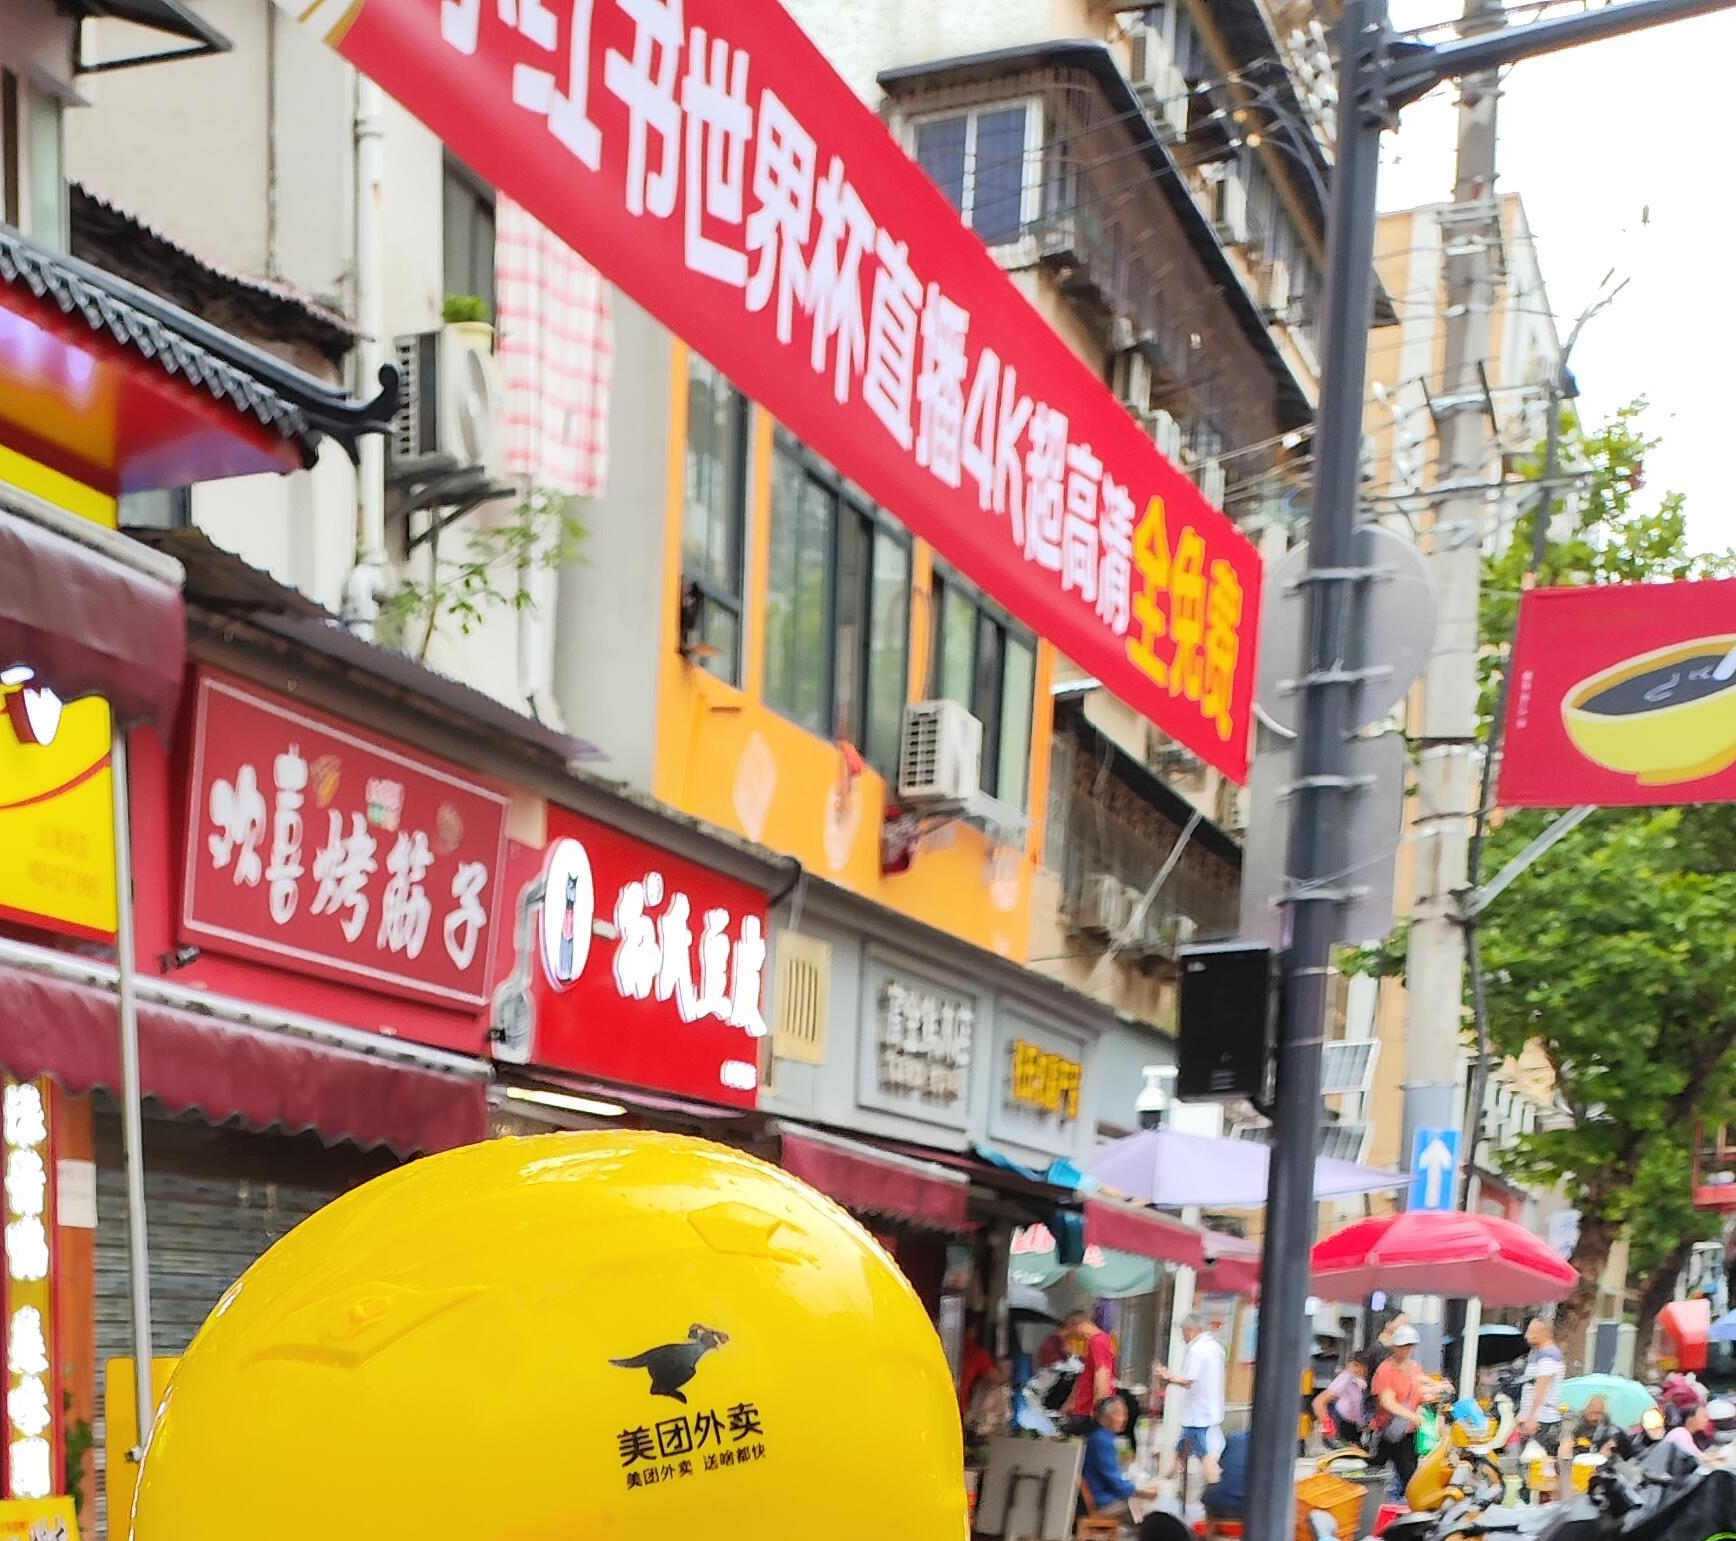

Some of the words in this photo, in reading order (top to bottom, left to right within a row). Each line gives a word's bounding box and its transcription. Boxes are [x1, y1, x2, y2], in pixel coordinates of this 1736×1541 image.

[616, 1402, 764, 1468] 美团外卖
[626, 1458, 694, 1490] 美团外卖
[703, 1442, 766, 1472] 送啥都快
